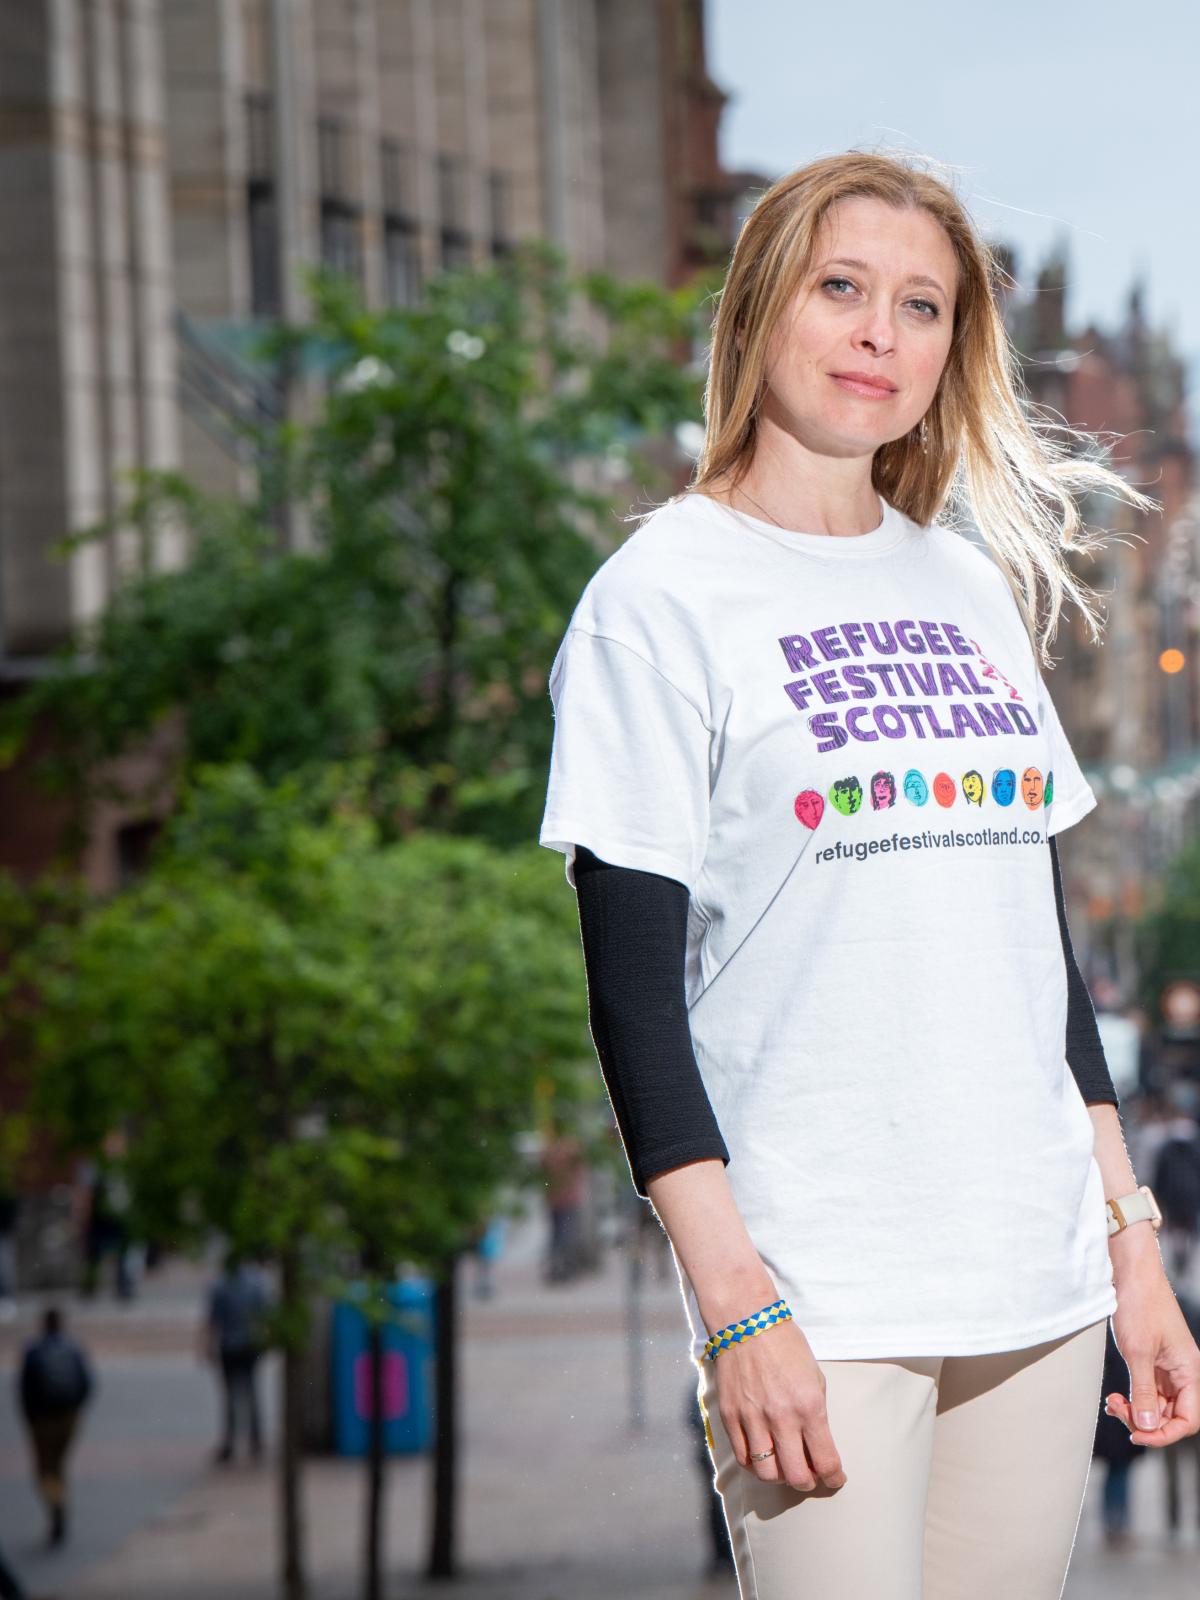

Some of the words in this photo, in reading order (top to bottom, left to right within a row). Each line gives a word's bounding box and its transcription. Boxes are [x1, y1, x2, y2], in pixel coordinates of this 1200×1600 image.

[778, 620, 975, 673] REFUGEE
[784, 663, 995, 711] FESTIVAL
[807, 702, 1039, 753] SCOTLAND
